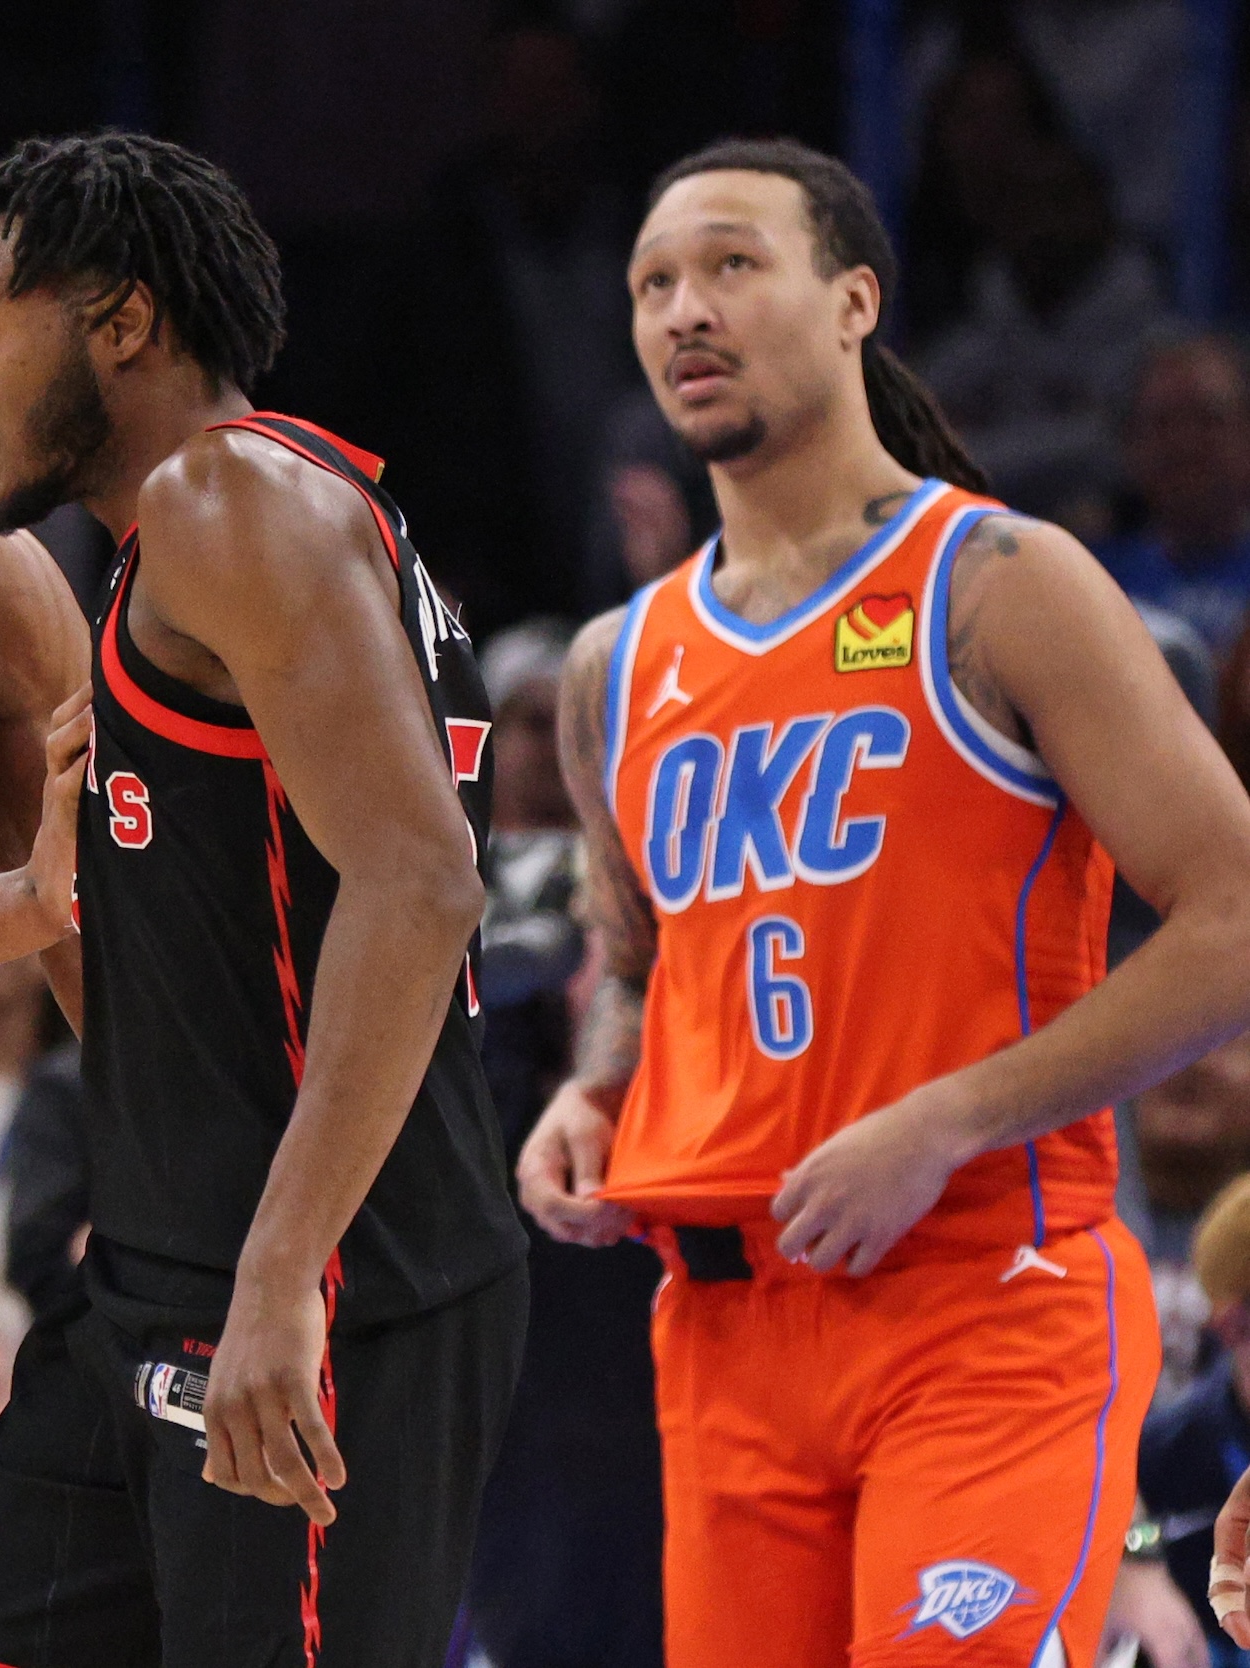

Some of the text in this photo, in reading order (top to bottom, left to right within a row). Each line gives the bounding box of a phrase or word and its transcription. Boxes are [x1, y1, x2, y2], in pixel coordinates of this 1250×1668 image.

[645, 705, 911, 914] OKC
[747, 915, 814, 1061] 6
[915, 1578, 996, 1623] OKC
